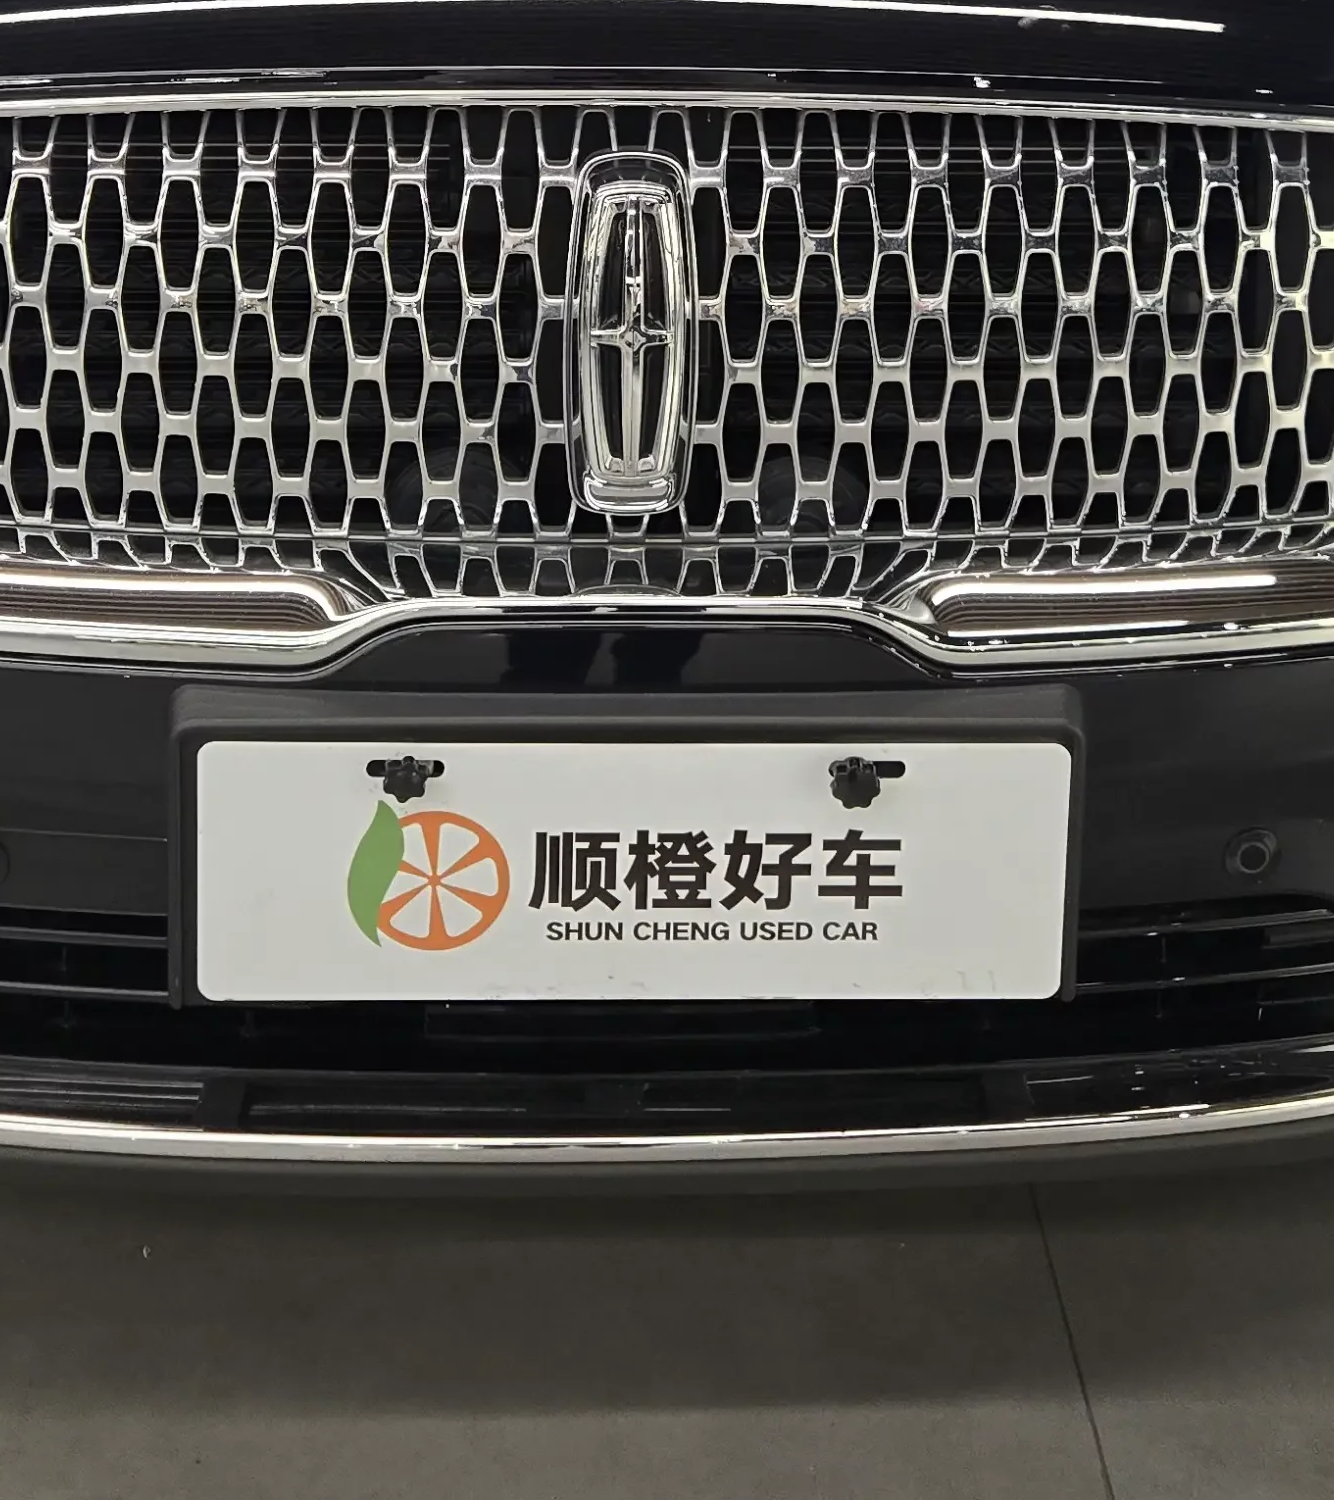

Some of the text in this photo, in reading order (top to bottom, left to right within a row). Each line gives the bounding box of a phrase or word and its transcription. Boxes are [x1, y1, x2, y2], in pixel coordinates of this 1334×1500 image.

[529, 829, 903, 912] 顺橙好车
[547, 921, 878, 941] SHUN CHENG USED CAR
